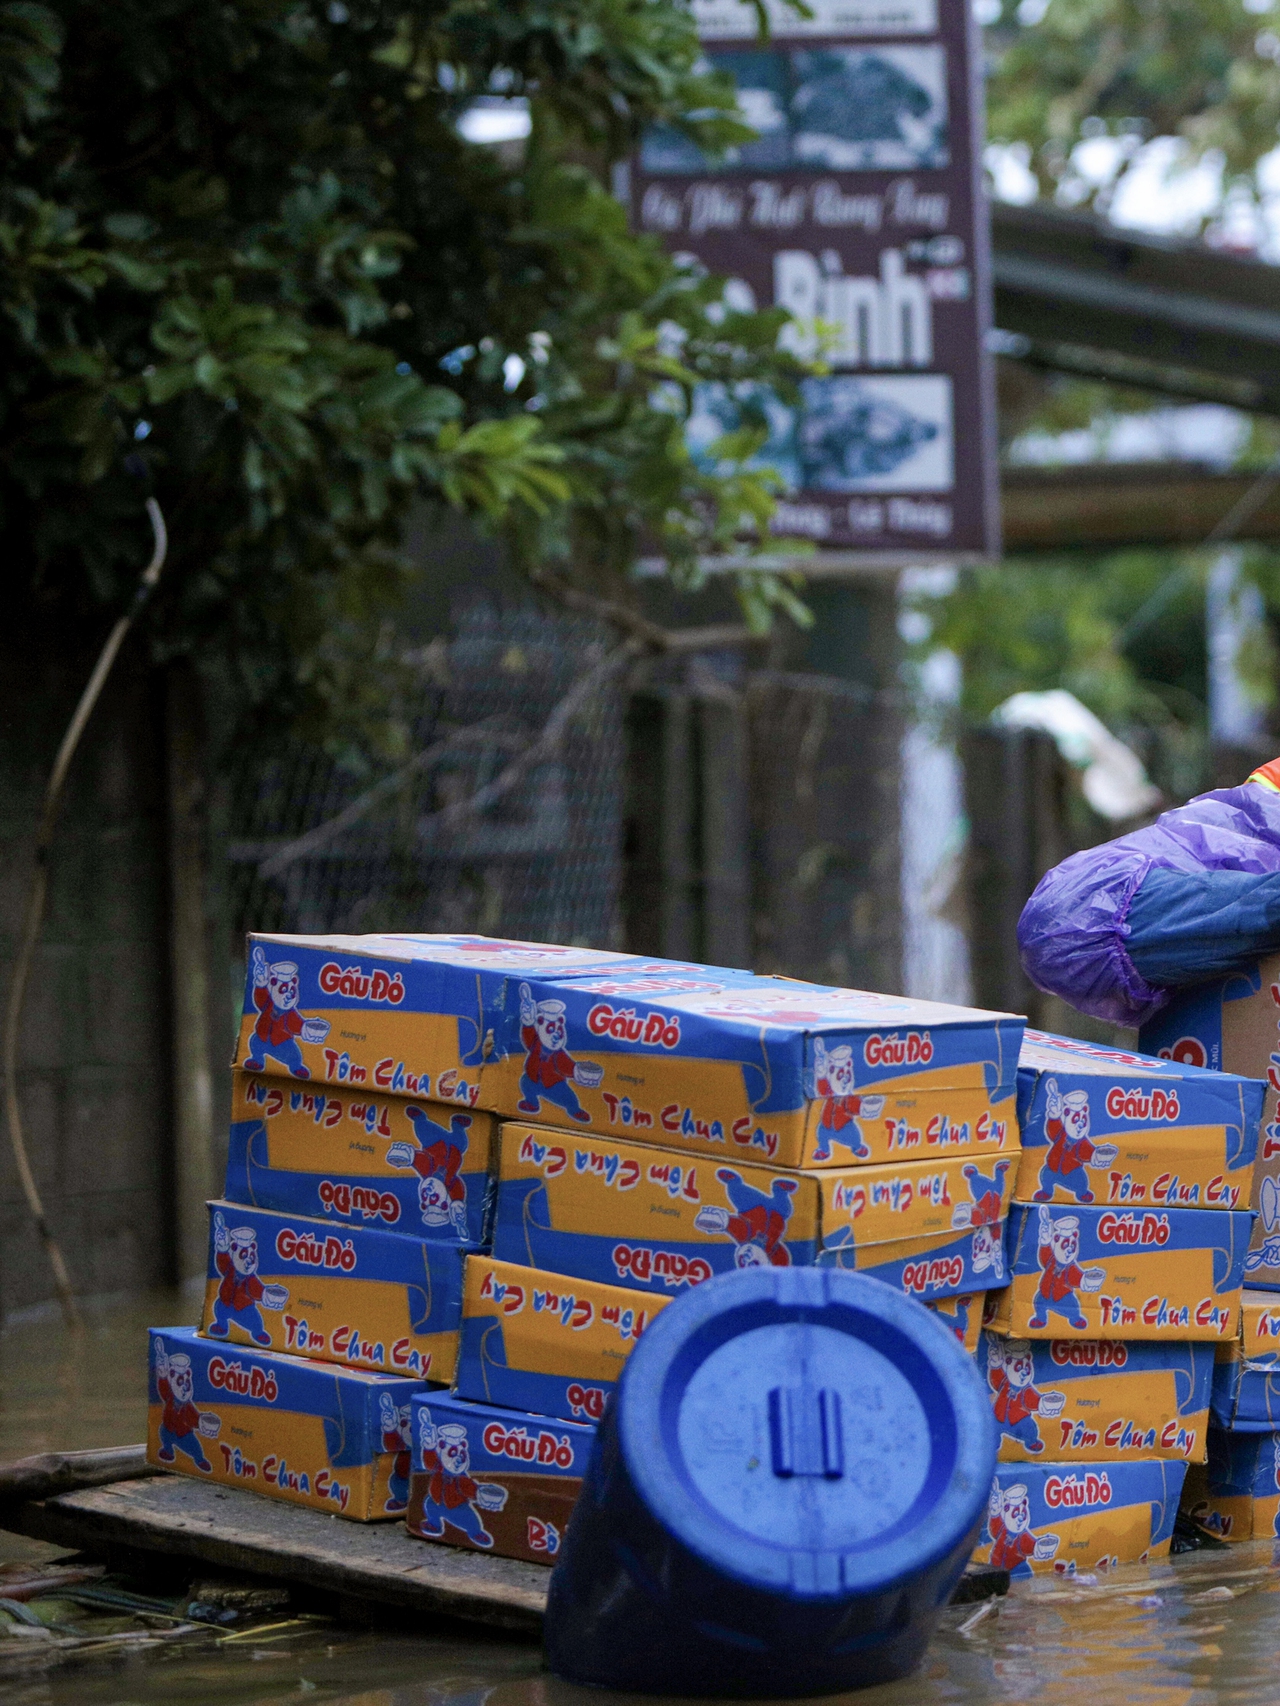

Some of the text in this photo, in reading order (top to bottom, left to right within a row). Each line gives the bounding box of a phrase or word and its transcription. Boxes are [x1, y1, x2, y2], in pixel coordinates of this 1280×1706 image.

[325, 1050, 480, 1107] Tôm Chua Cay
[245, 1081, 391, 1136] Tôm Chua Cay
[603, 1093, 777, 1156] Tôm Chua Cay
[885, 1114, 1004, 1147] Tôm Chua Cay
[521, 1135, 699, 1199] Tôm Chua Cay
[1111, 1172, 1240, 1205] Tôm Chua Cay
[834, 1176, 951, 1220] Tôm Chua Cay
[480, 1273, 523, 1312] Cay
[533, 1290, 592, 1327] Chua
[1101, 1296, 1229, 1332] Tôm Chua Cay
[285, 1316, 431, 1379] Tôm Chua Cay
[1060, 1420, 1193, 1455] Tôm Chua Cay
[220, 1445, 350, 1511] Tôm Chua Cay
